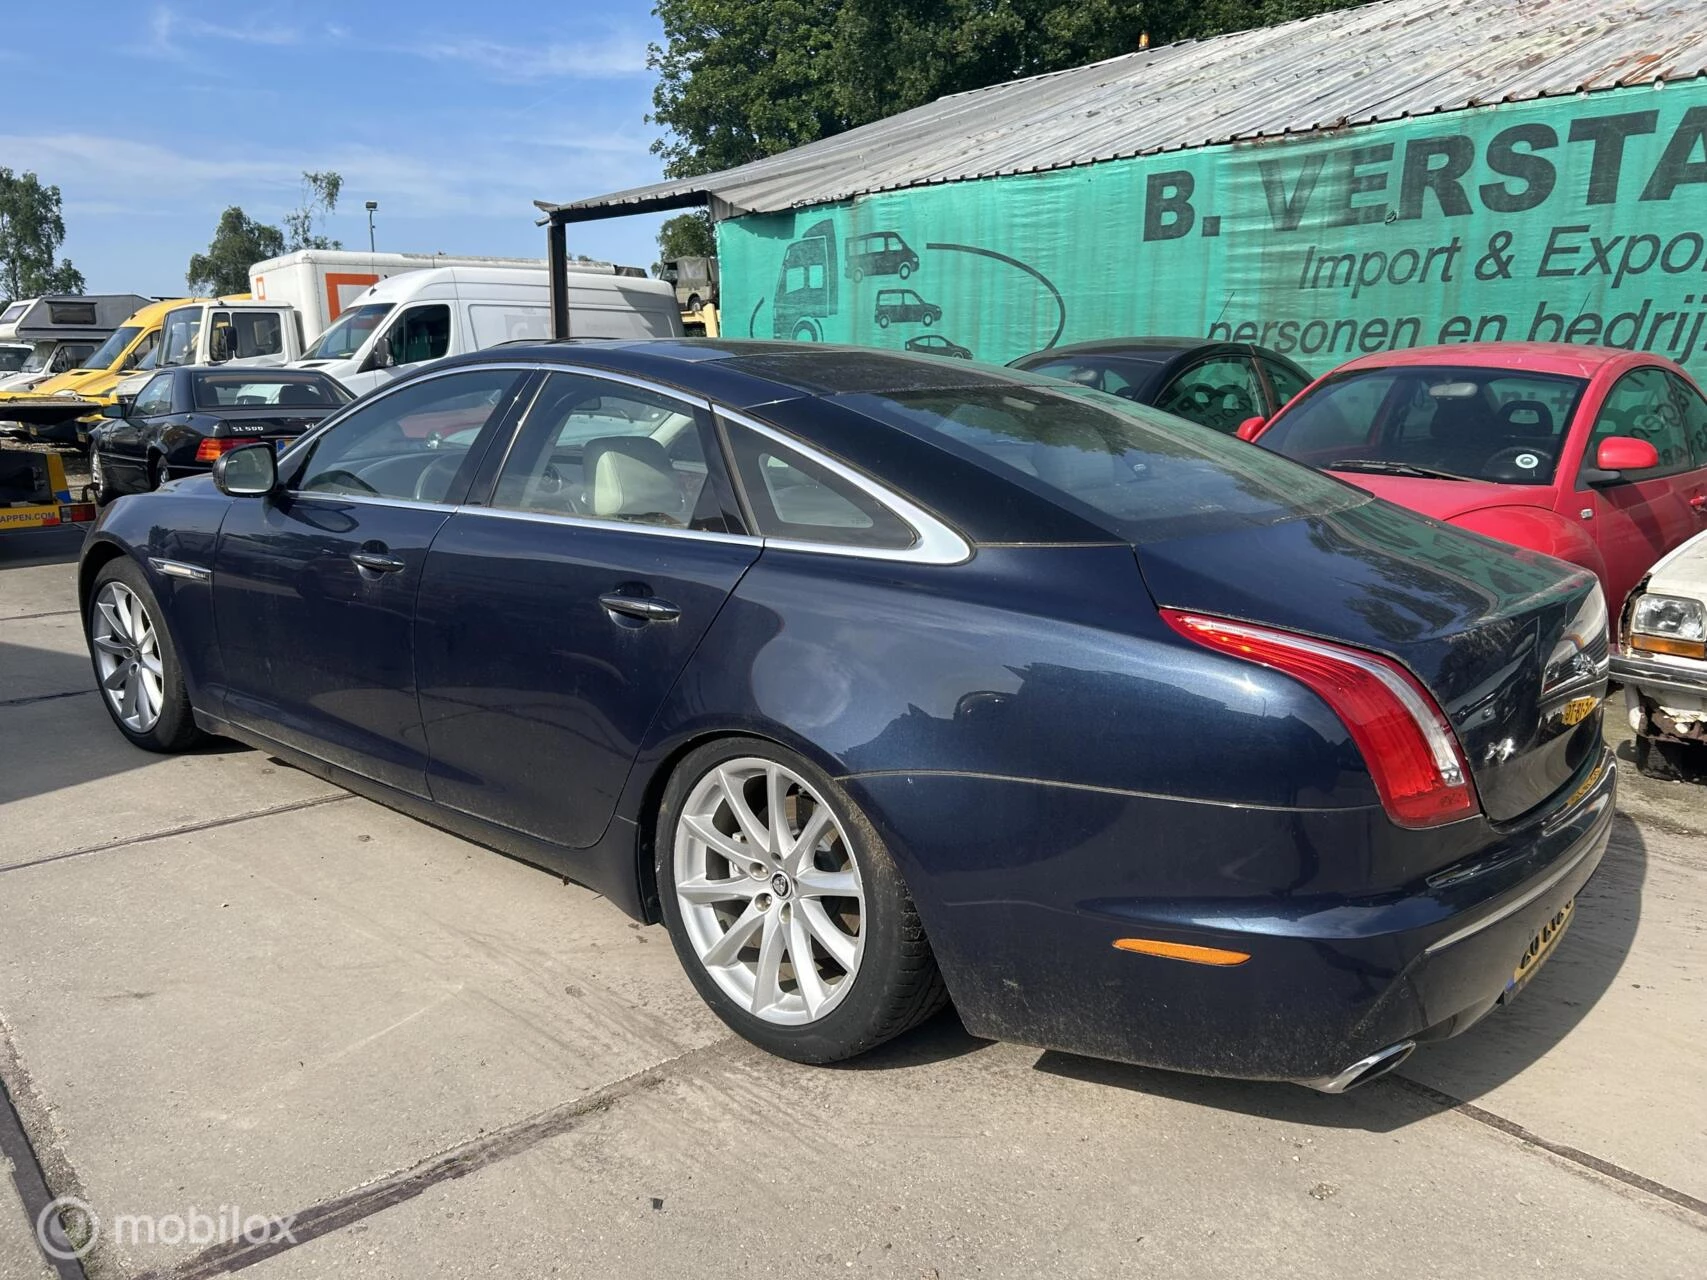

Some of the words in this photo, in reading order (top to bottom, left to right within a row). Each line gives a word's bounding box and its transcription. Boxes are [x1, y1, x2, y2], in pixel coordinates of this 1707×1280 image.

[1143, 170, 1221, 242] B.
[1299, 236, 1461, 299] Import
[1474, 230, 1514, 280] &
[1536, 223, 1707, 289] Expo
[1438, 313, 1508, 345] en
[1527, 294, 1707, 365] bedrij
